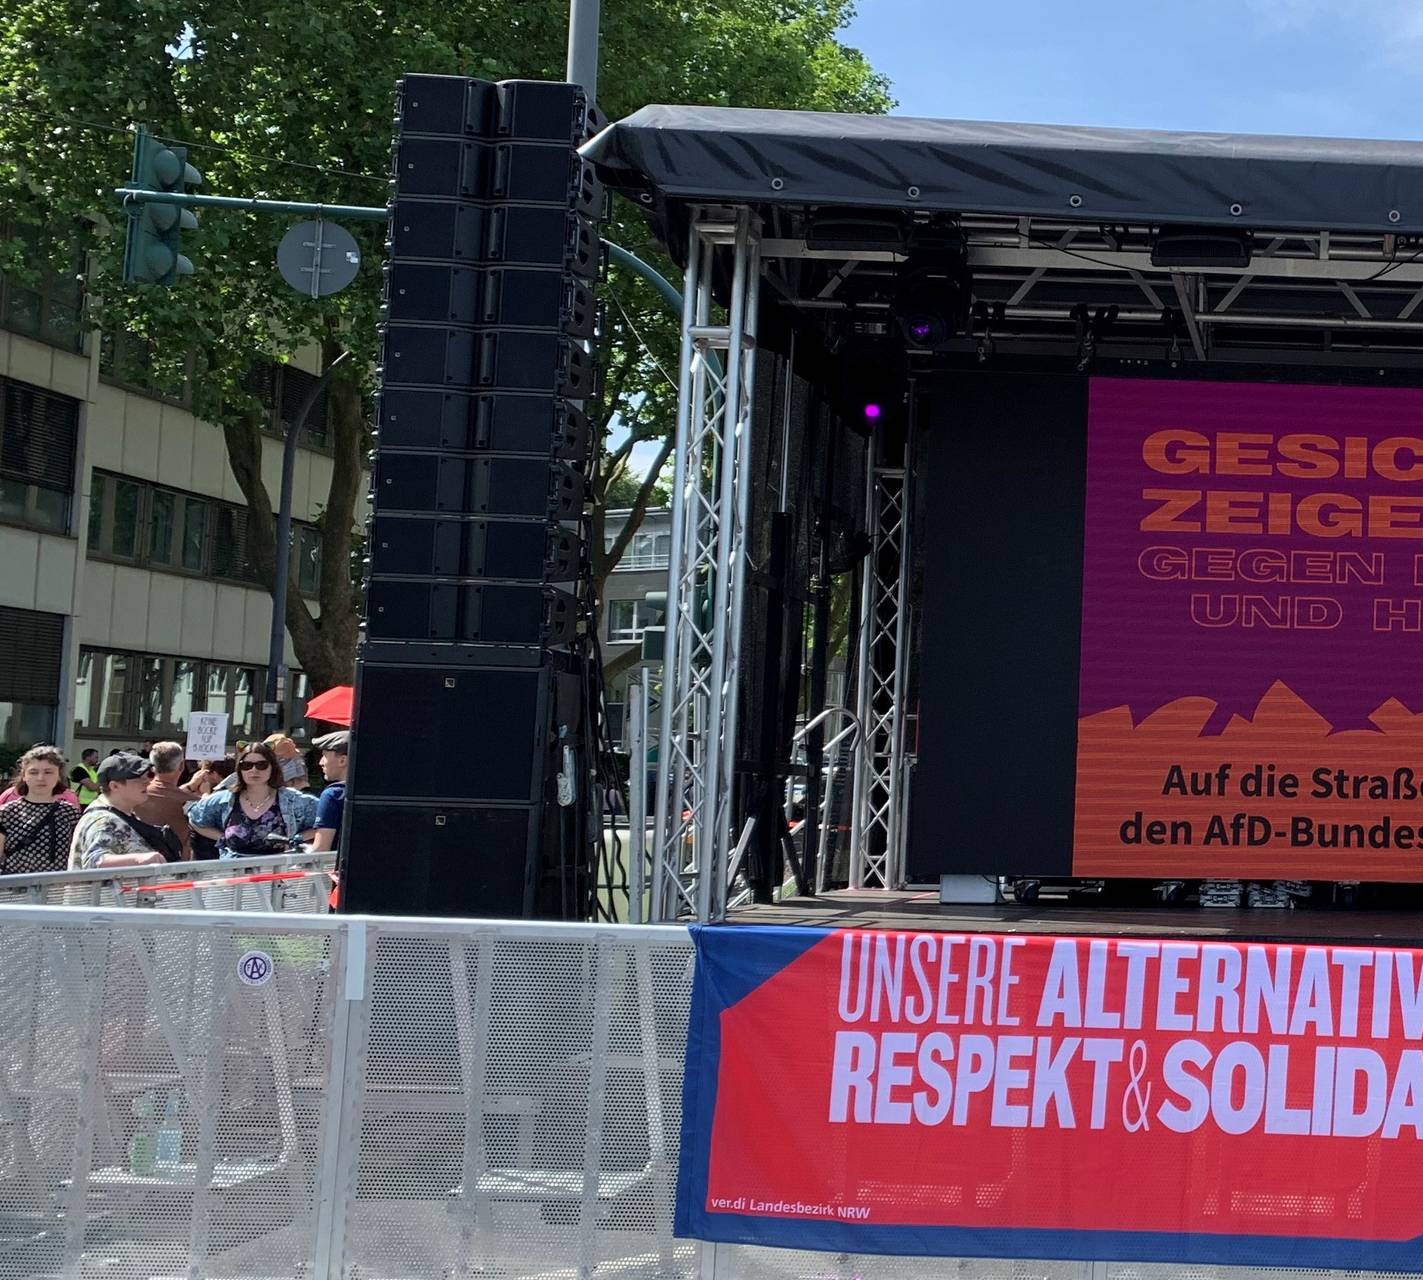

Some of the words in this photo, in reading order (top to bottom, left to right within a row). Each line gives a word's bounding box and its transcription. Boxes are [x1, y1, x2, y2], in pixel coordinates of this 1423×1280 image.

[1138, 546, 1384, 585] GEGEN
[1191, 595, 1343, 630] UND
[1163, 764, 1231, 797] Auf
[1241, 764, 1299, 798] die
[1120, 812, 1192, 845] den
[838, 932, 1026, 1026] UNSERE
[829, 1031, 1124, 1129] RESPEKT
[711, 1198, 746, 1210] ver.di
[749, 1199, 834, 1216] Landesbezirk
[837, 1206, 870, 1219] NRW
